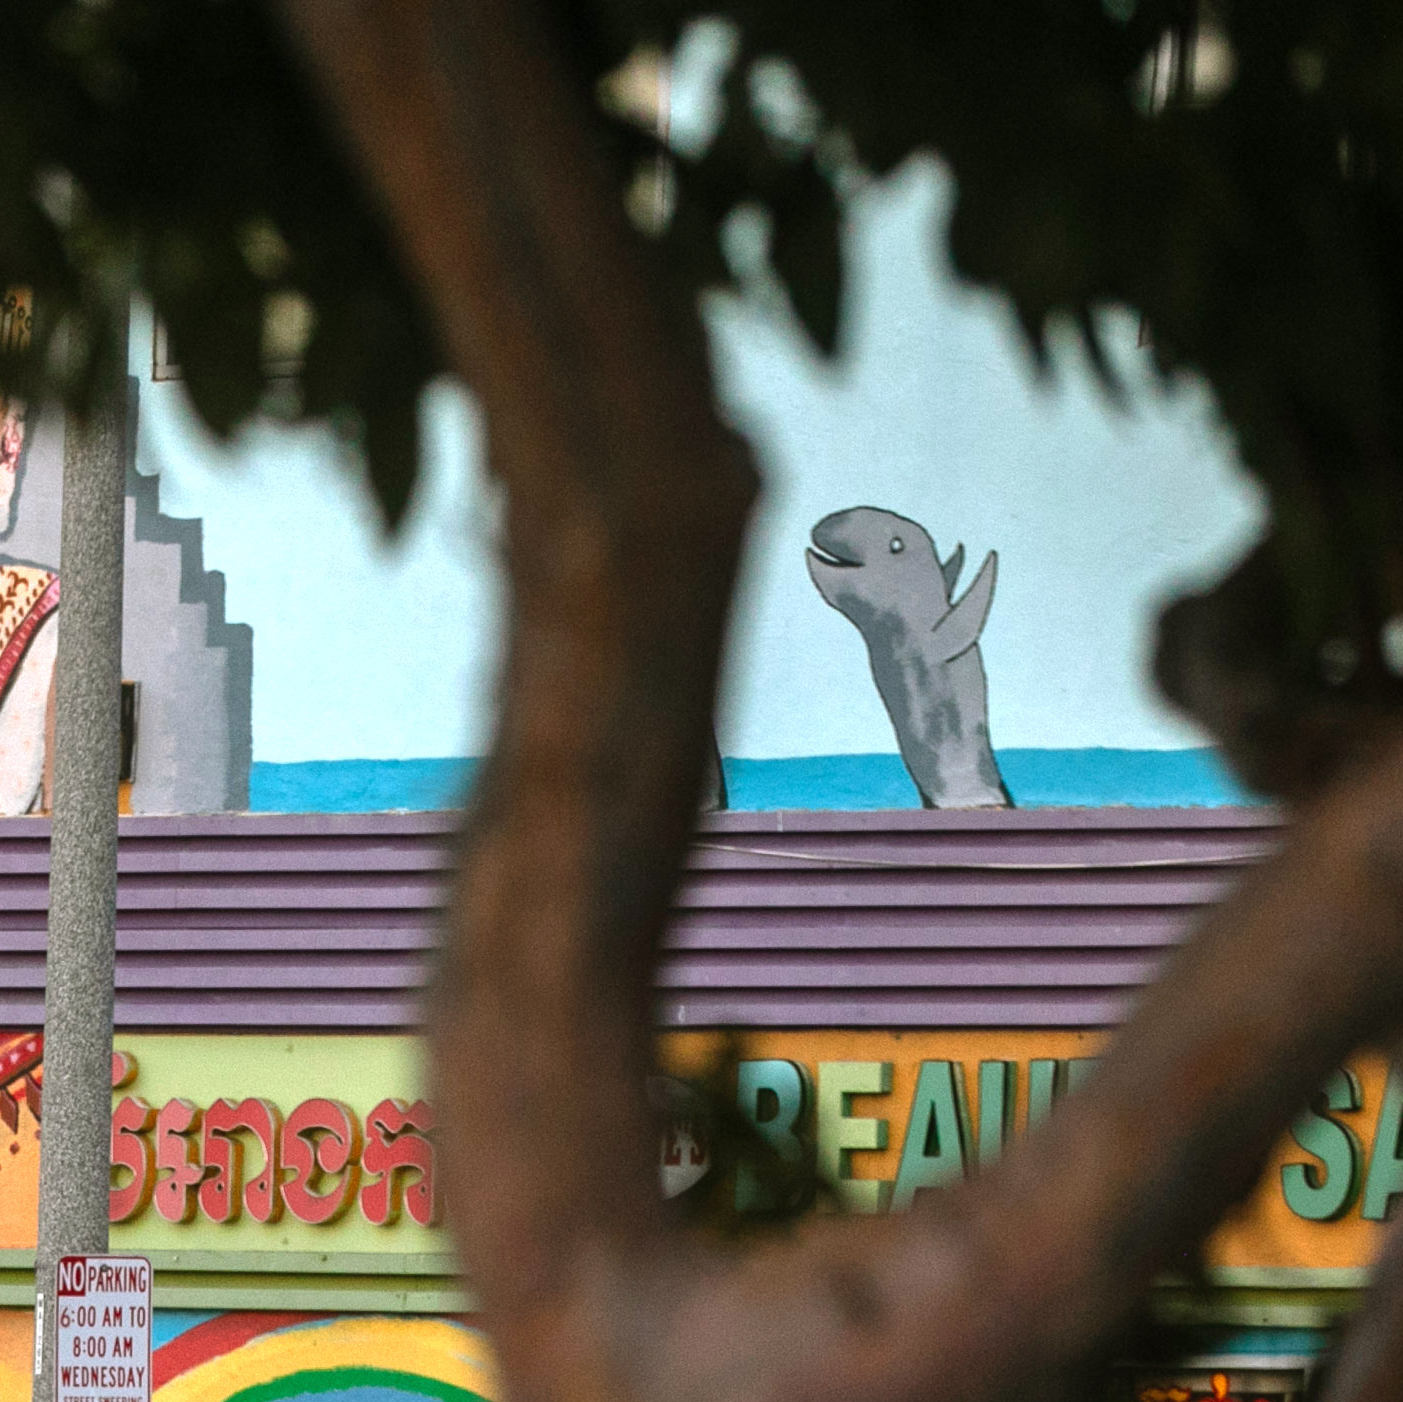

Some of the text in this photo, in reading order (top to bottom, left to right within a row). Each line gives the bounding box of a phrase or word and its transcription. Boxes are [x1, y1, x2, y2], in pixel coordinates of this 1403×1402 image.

[59, 1262, 146, 1293] NO PARKING
[60, 1306, 146, 1328] 6:00 AM TO
[73, 1336, 133, 1358] 8:00 AM
[61, 1366, 145, 1388] WEDNESDAY
